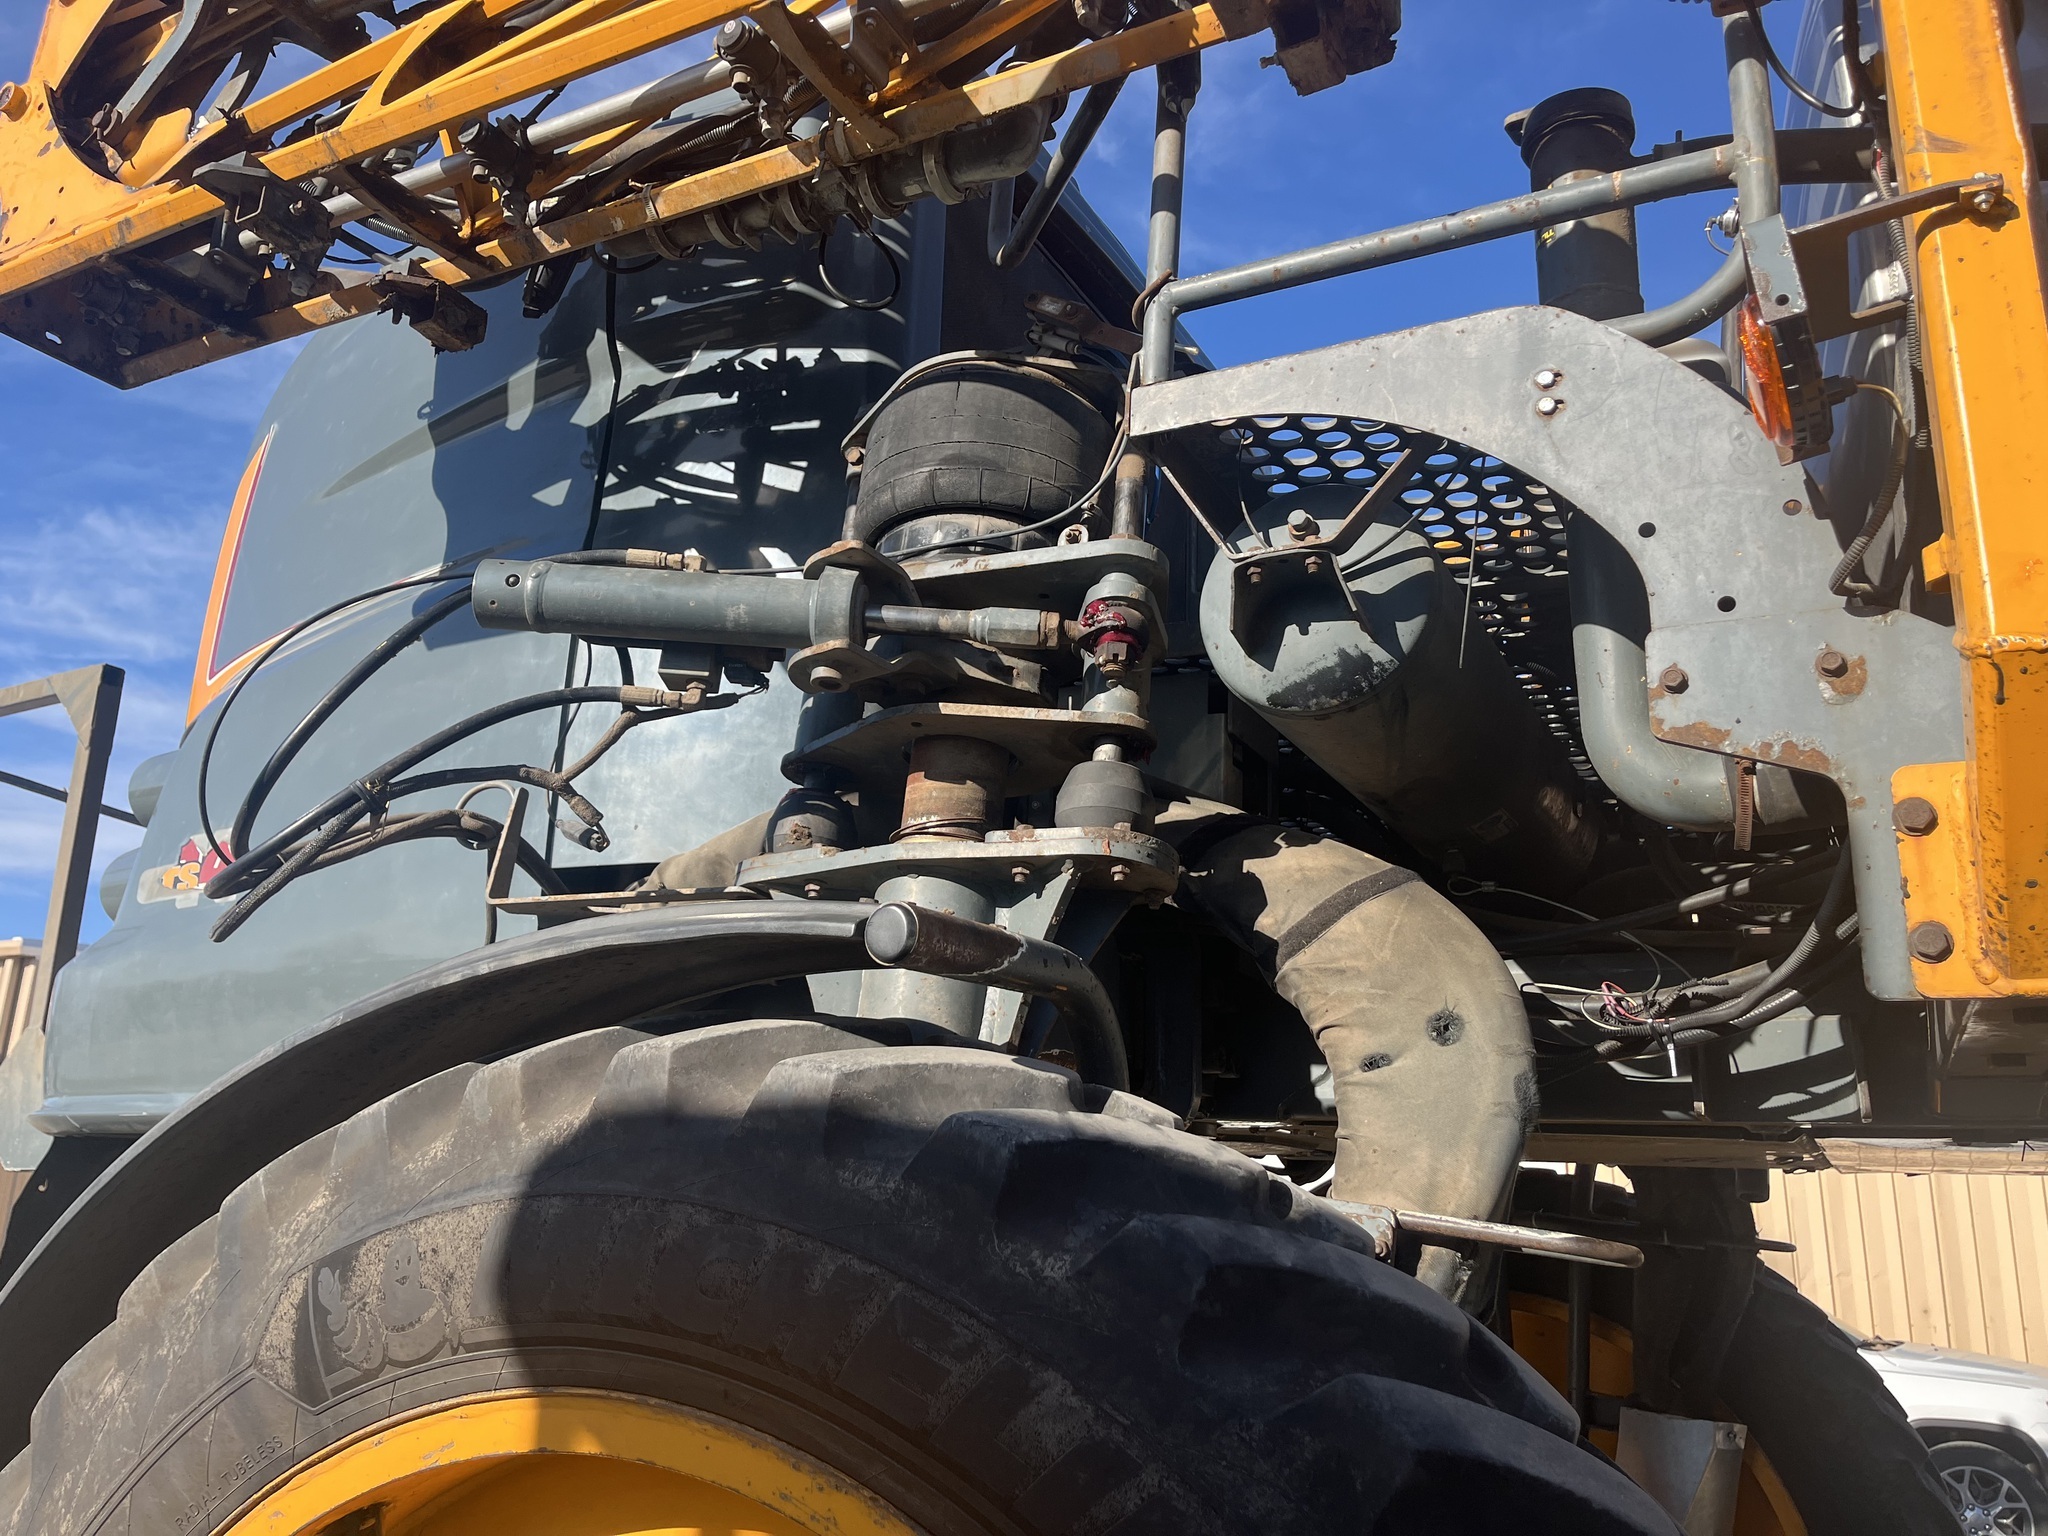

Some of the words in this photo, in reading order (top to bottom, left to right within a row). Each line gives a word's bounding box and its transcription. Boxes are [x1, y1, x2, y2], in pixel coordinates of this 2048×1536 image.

[470, 1205, 1205, 1536] MICHELI
[175, 1491, 217, 1531] RADIAL
[220, 1435, 283, 1486] TUBELESS
